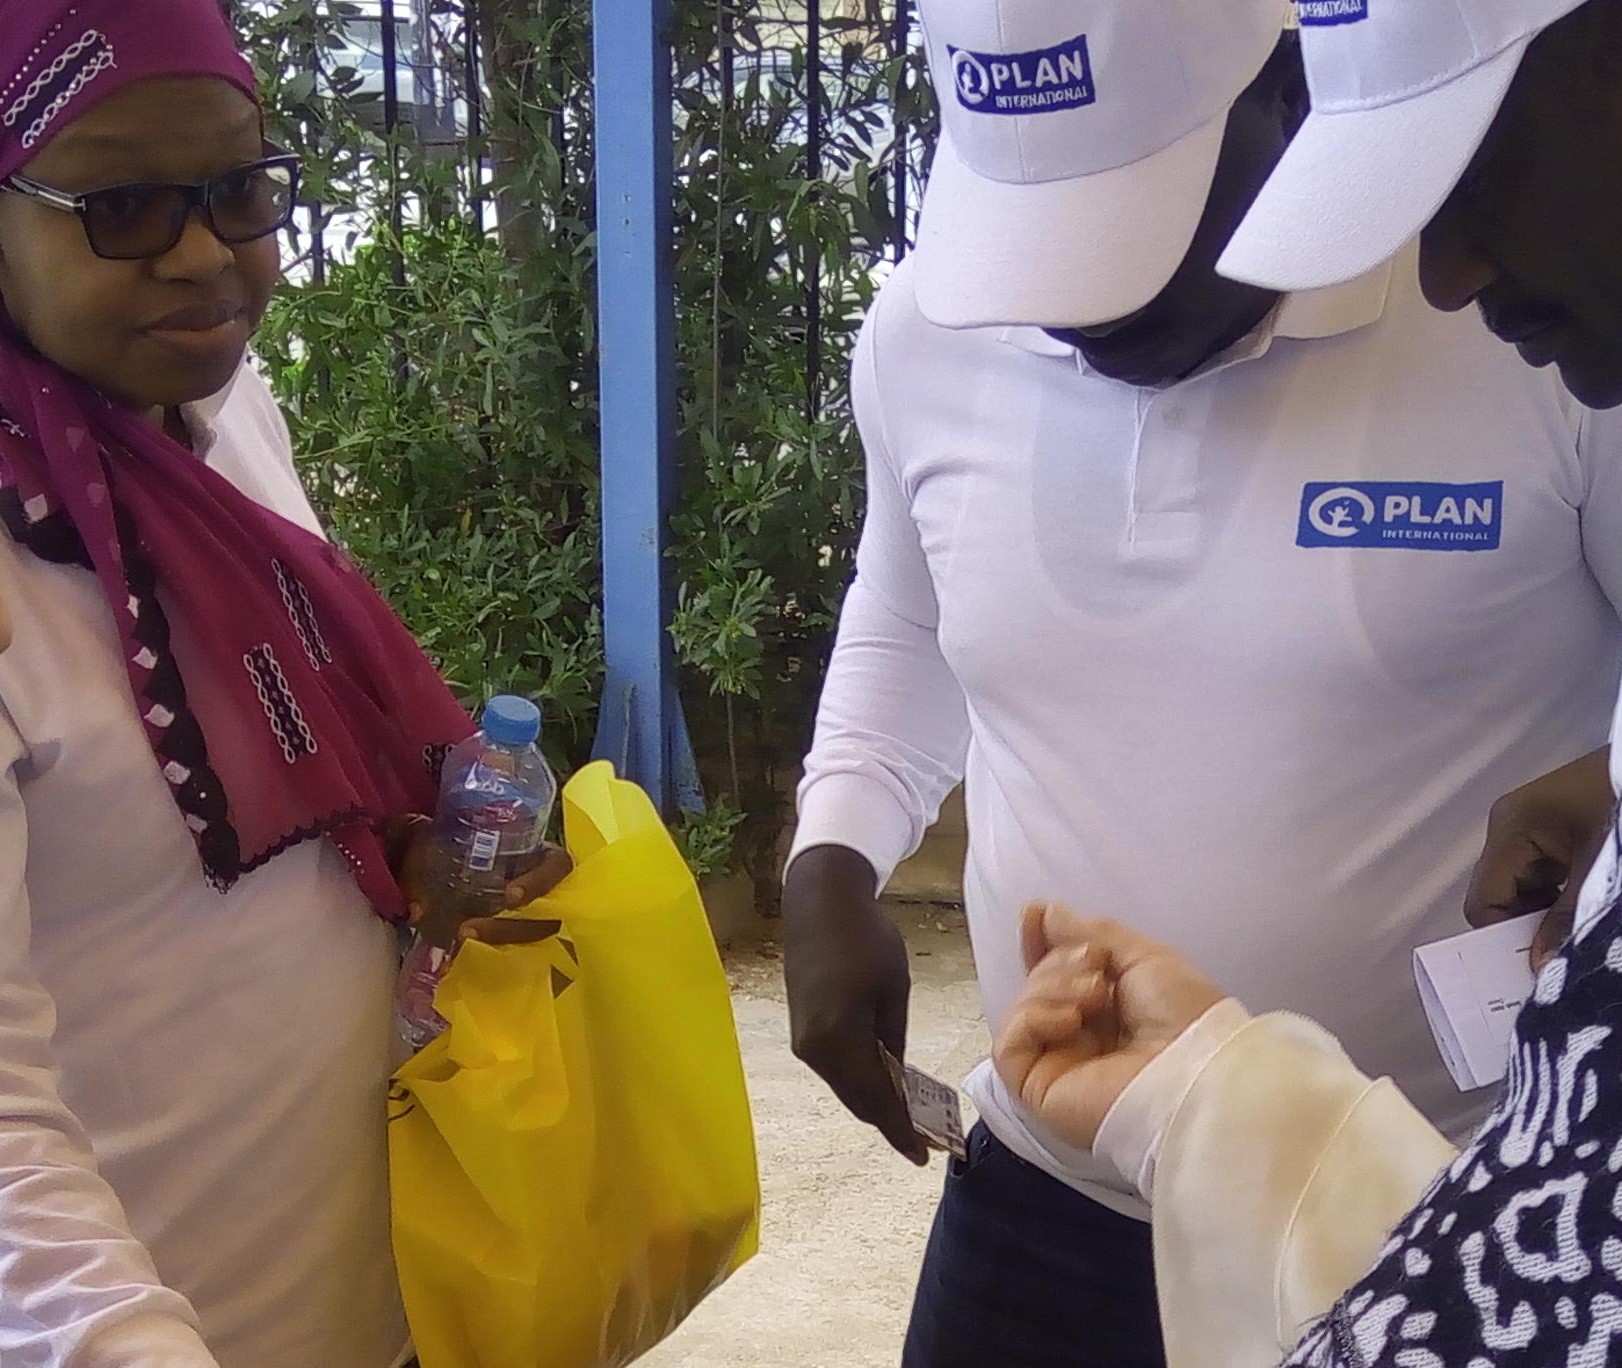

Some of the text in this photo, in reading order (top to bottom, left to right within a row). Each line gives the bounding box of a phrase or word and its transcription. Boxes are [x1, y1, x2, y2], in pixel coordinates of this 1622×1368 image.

[990, 50, 1084, 90] PLAN
[994, 86, 1088, 109] INTERNATIONAL
[1383, 495, 1493, 525] PLAN
[1382, 529, 1489, 541] INTERNATIONAL
